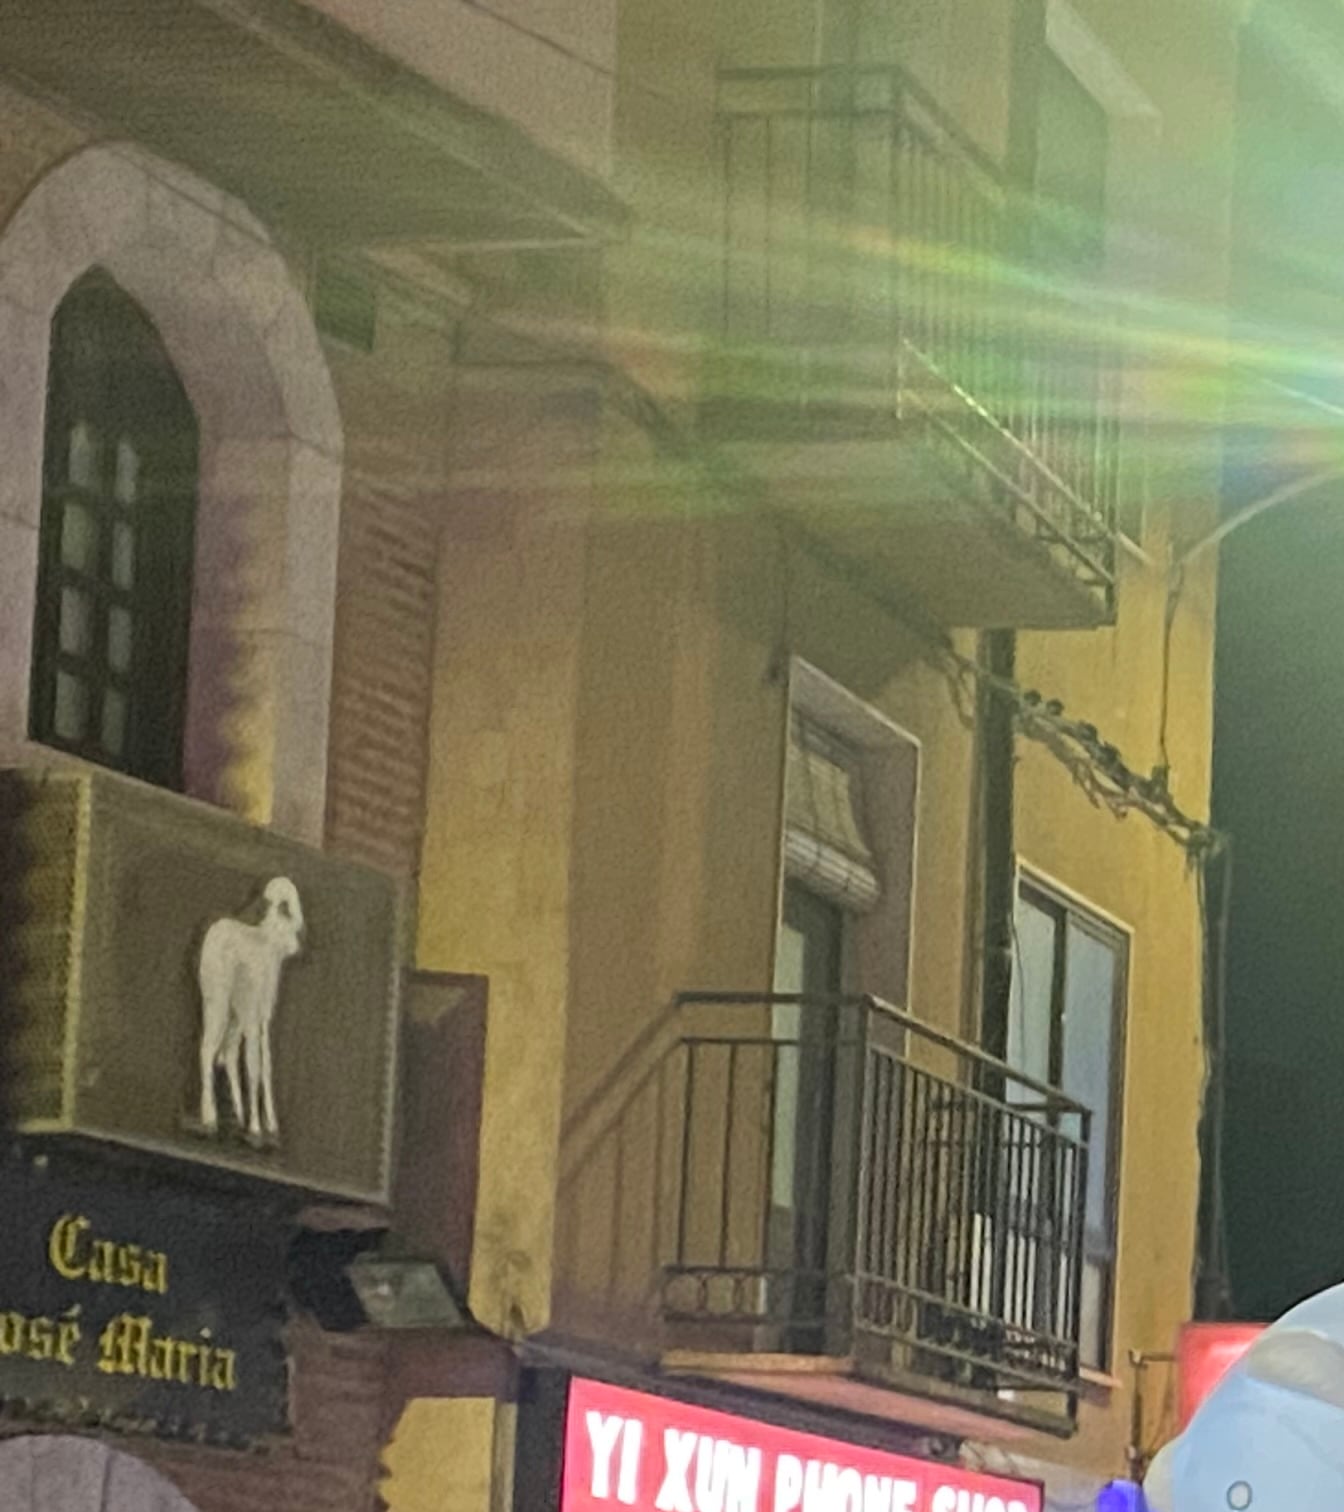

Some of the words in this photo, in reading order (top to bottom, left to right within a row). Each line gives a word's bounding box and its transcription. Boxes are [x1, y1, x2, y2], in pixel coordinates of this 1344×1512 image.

[49, 1212, 169, 1295] Casa
[0, 1303, 82, 1366] osé
[585, 1409, 643, 1505] YI
